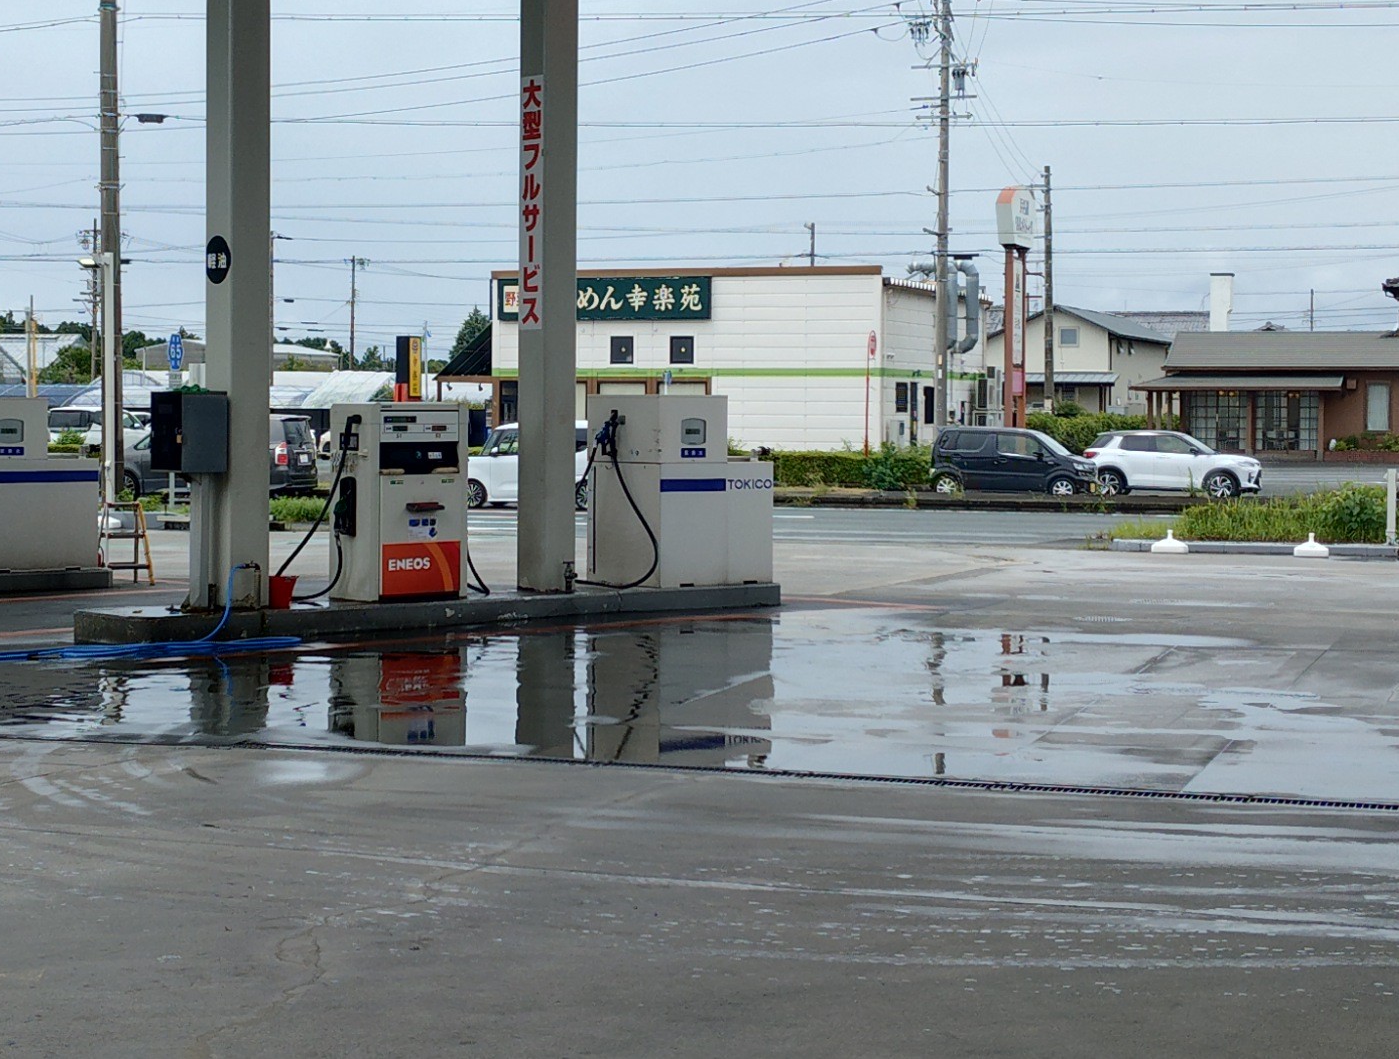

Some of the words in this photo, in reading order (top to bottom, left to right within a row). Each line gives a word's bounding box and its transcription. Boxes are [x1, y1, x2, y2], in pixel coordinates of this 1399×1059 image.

[521, 78, 542, 326] 大型フルサービス
[576, 283, 703, 312] めん幸楽苑
[727, 478, 773, 490] TOKICO
[387, 557, 431, 572] ENEOS
